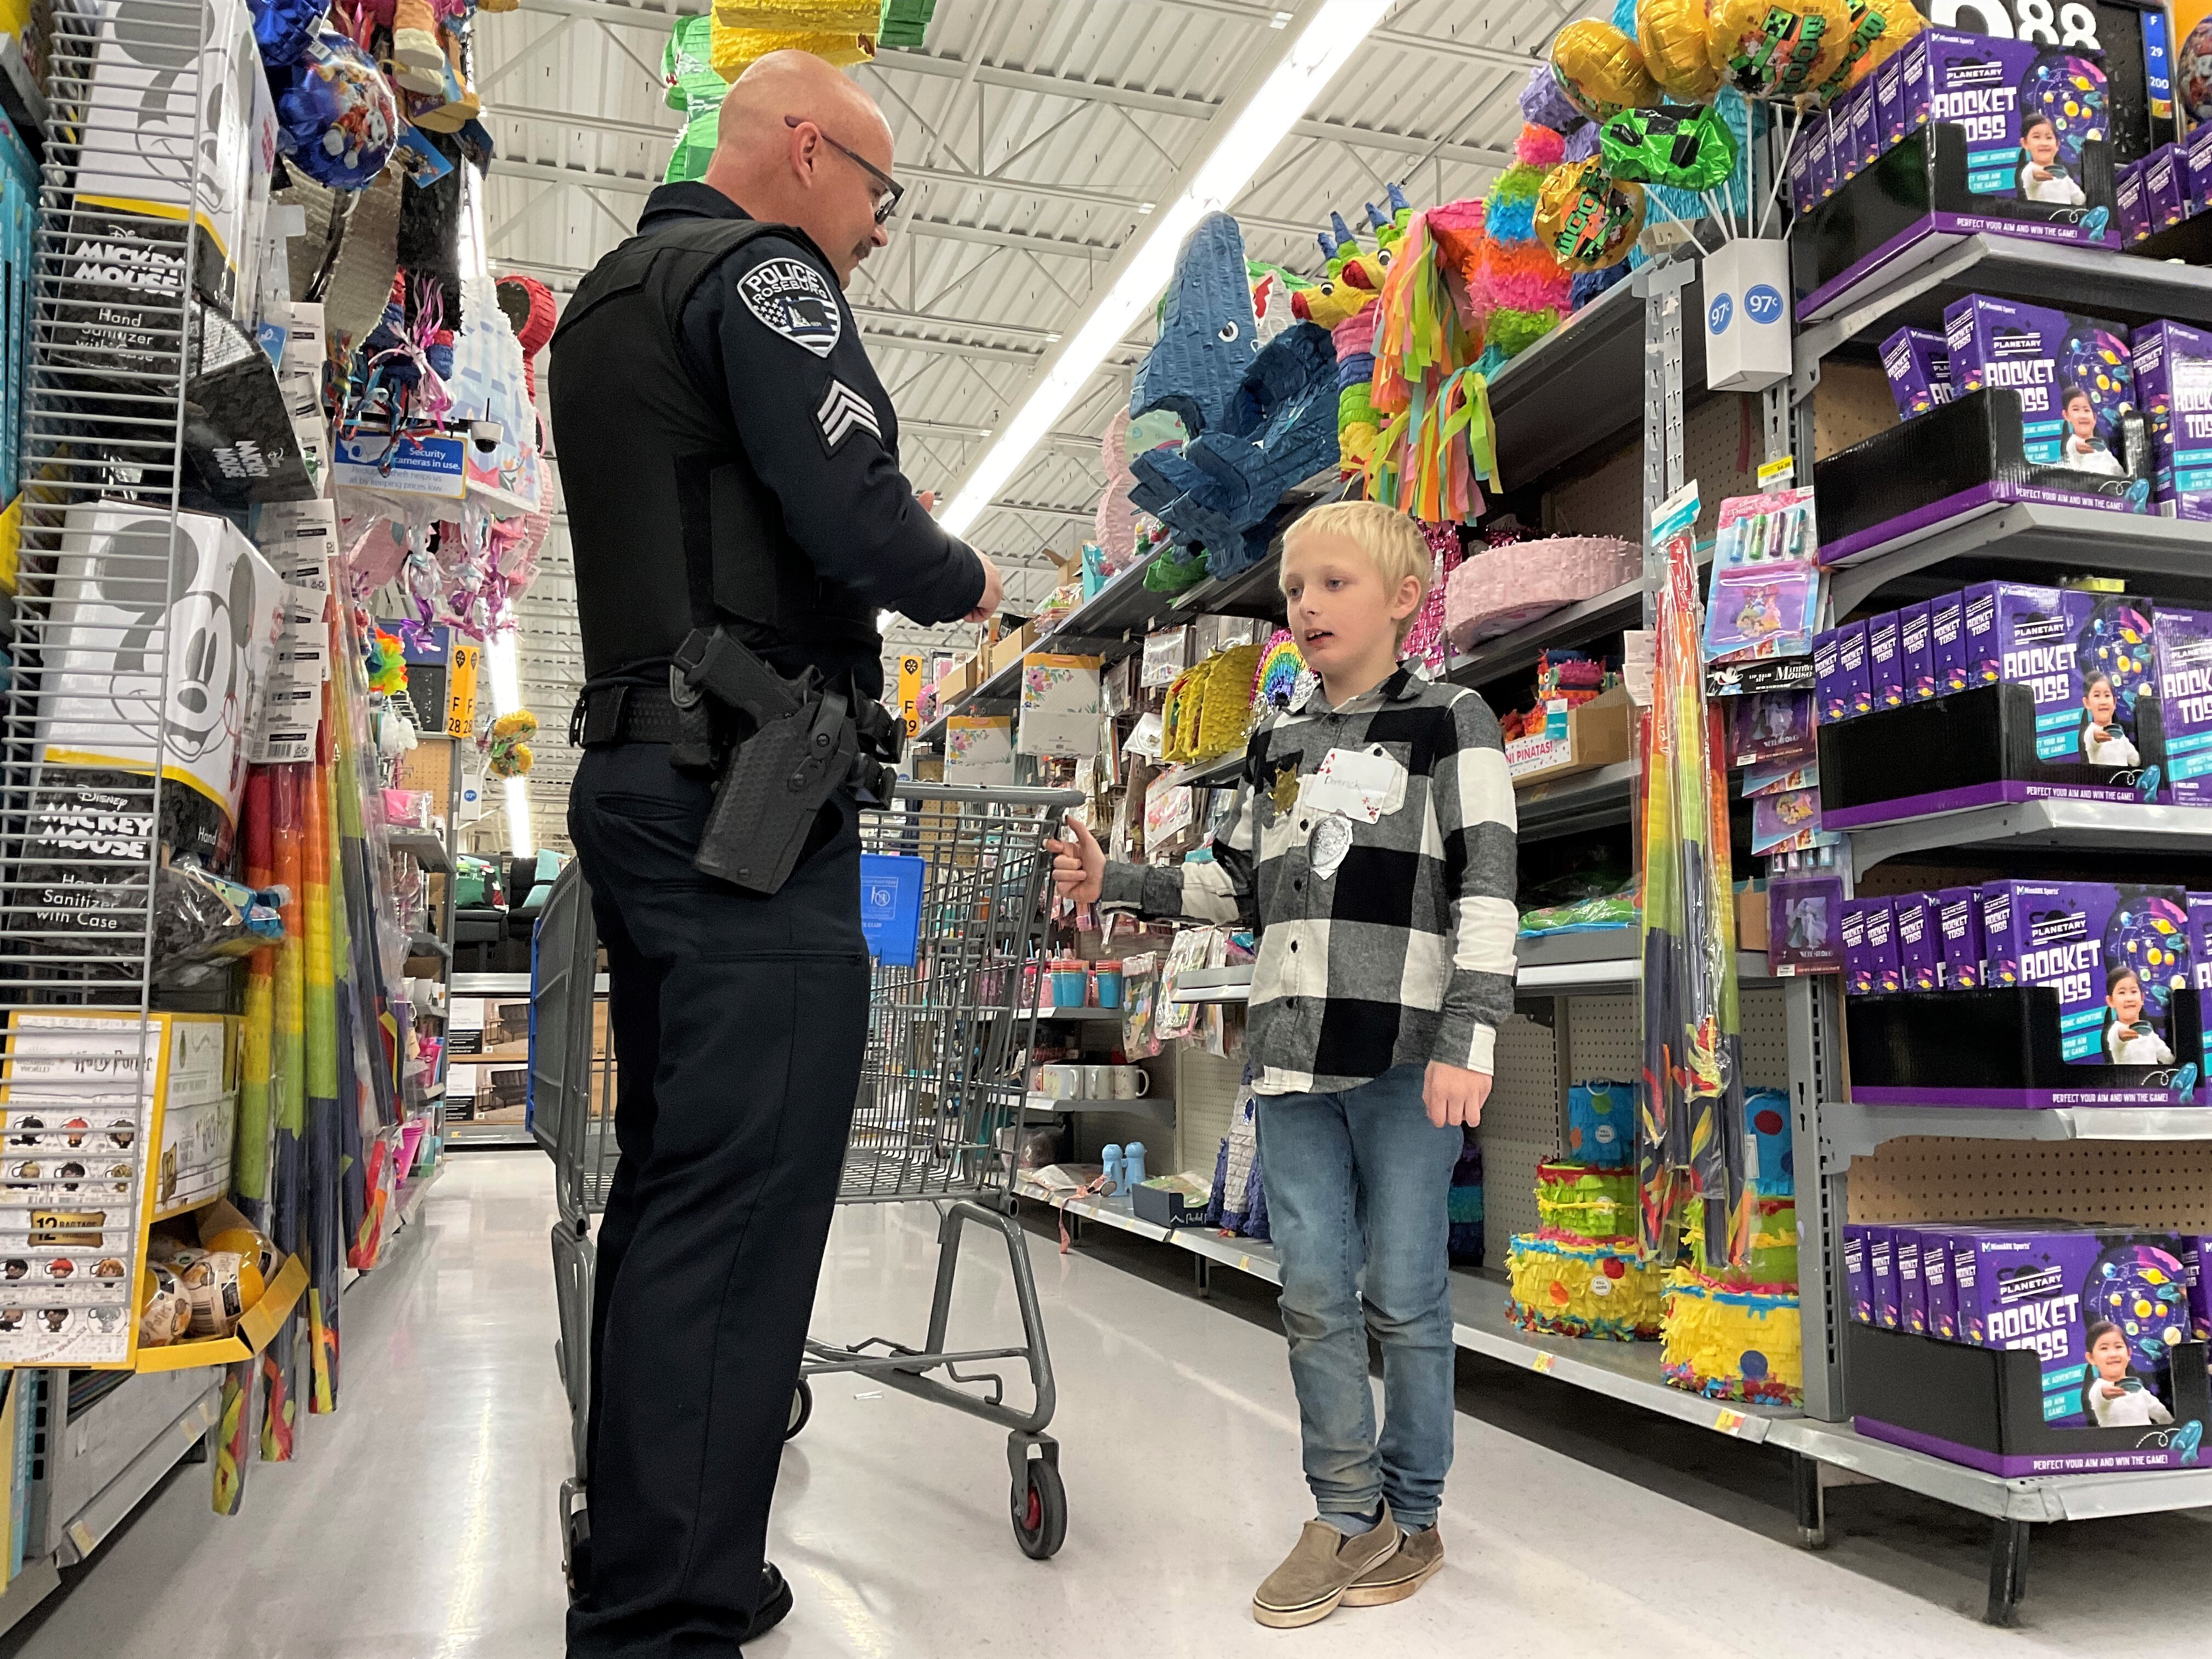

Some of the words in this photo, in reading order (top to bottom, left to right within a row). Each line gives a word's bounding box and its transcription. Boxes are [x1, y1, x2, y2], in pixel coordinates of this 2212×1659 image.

[2151, 16, 2158, 25] F
[2150, 46, 2163, 57] 29
[1946, 69, 2002, 80] PLANETARY
[2150, 76, 2169, 89] 200
[1934, 87, 2017, 119] ROCKET
[1957, 217, 1984, 228] PERFECT
[1986, 220, 2002, 230] YOUR
[2003, 223, 2015, 232] AIM
[2016, 224, 2029, 233] AND
[2030, 225, 2043, 235] WIN
[2044, 227, 2056, 236] THE
[2058, 229, 2078, 239] GAME!
[75, 240, 185, 276] MICKEY
[74, 262, 178, 297] MOUSE
[746, 263, 820, 292] POLICE
[752, 280, 828, 304] ROSEBURG
[99, 308, 142, 328] Hand
[1948, 321, 1974, 347] ROCKET
[1953, 333, 1971, 352] TOSS
[1994, 340, 2041, 349] PLANETARY
[1888, 349, 1910, 378] ROCKET
[2134, 346, 2163, 369] ROCKET
[2140, 358, 2159, 375] TOSS
[1894, 362, 1911, 381] TOSS
[1985, 359, 2055, 387] ROCKET
[2175, 387, 2212, 411] ROCK
[2185, 413, 2212, 438] TOS
[409, 447, 446, 459] Security
[394, 457, 431, 467] cameras
[432, 458, 441, 467] in
[443, 461, 461, 470] use.
[359, 477, 369, 486] by
[370, 479, 402, 489] keeping
[403, 481, 427, 491] prices
[410, 472, 431, 481] helps
[2016, 487, 2041, 498] PERFECT
[2041, 491, 2056, 500] YOUR
[2057, 493, 2068, 502] AIM
[2069, 495, 2081, 504] AND
[2082, 497, 2093, 506] WIN
[2095, 499, 2104, 507] THE
[2106, 500, 2123, 510] GAME!
[1967, 608, 1994, 629] ROCKET
[1934, 618, 1960, 639] ROCKET
[1972, 620, 1990, 636] TOSS
[2014, 624, 2064, 637] PLANETARY
[1903, 628, 1928, 647] ROCKET
[1908, 639, 1925, 654] TOSS
[1939, 630, 1957, 646] TOSS
[1841, 645, 1864, 666] ROCKET
[1872, 637, 1897, 657] ROCKET
[1876, 648, 1893, 663] TOSS
[1815, 653, 1837, 673] ROCKET
[1845, 657, 1861, 672] TOSS
[2004, 644, 2078, 679] ROCKET
[1819, 664, 1835, 679] TOSS
[2163, 668, 2212, 699] ROCK
[453, 697, 460, 712] F
[467, 698, 473, 714] F
[905, 701, 914, 713] F
[2179, 698, 2212, 724] TOS
[449, 718, 460, 733] 28
[464, 720, 472, 734] 28
[2057, 712, 2080, 724] ADVENTURE
[2041, 738, 2056, 747] YOUR
[2057, 735, 2066, 744] AIM
[2041, 746, 2052, 754] THE
[2053, 743, 2066, 753] GAME!
[1505, 753, 1514, 764] NI
[1516, 740, 1553, 761] PINATAS!
[2027, 786, 2052, 796] PERFECT
[2052, 788, 2067, 797] YOUR
[2068, 789, 2079, 798] AIM
[2080, 790, 2091, 799] AND
[2092, 791, 2104, 799] WIN
[2105, 791, 2116, 800] THE
[2117, 792, 2134, 801] GAME!
[39, 802, 154, 836] MICKEY
[38, 825, 146, 859] MOUSE
[198, 826, 217, 845] Hand
[43, 889, 119, 909] Sanitizer
[37, 911, 70, 923] with
[77, 912, 117, 929] Case
[1942, 914, 1968, 932] ROCKET
[1985, 908, 2011, 926] ROCKET
[1842, 924, 1864, 941] ROCKET
[1867, 922, 1891, 939] ROCKET
[1900, 919, 1924, 937] ROCKET
[1947, 926, 1965, 940] TOSS
[1989, 919, 2008, 934] TOSS
[2032, 919, 2086, 938] PLANETARY
[1846, 935, 1862, 948] TOSS
[1871, 933, 1888, 947] TOSS
[1905, 930, 1922, 944] TOSS
[2021, 939, 2102, 982] ROCKET
[2036, 972, 2092, 1005] OSS
[2076, 1011, 2103, 1025] ADVENTURE
[2077, 1036, 2087, 1045] AIM
[2072, 1045, 2088, 1056] GAME!
[113, 1050, 153, 1076] Pottr
[2053, 1093, 2079, 1103] PERFECT
[2080, 1093, 2096, 1102] YOUR
[2097, 1093, 2109, 1102] AIM
[2110, 1093, 2122, 1102] AND
[2123, 1093, 2136, 1102] WIN
[2136, 1093, 2148, 1102] THE
[2149, 1093, 2168, 1102] GAME!
[37, 1217, 58, 1241] 12
[2000, 1274, 2062, 1296] PLANETARY
[1988, 1294, 2079, 1341] ROCKET
[2005, 1329, 2069, 1362] OSS
[2052, 1369, 2082, 1383] ADVENTURE
[2054, 1396, 2065, 1405] AIM
[2048, 1405, 2067, 1417] GAME!
[2033, 1459, 2063, 1471] PERFECT
[2066, 1458, 2084, 1469] YOUR
[2085, 1457, 2098, 1468] AIM
[2100, 1457, 2114, 1466] AND
[2115, 1457, 2130, 1466] WIN
[2132, 1455, 2145, 1465] THE
[2147, 1455, 2168, 1464] GAME!
